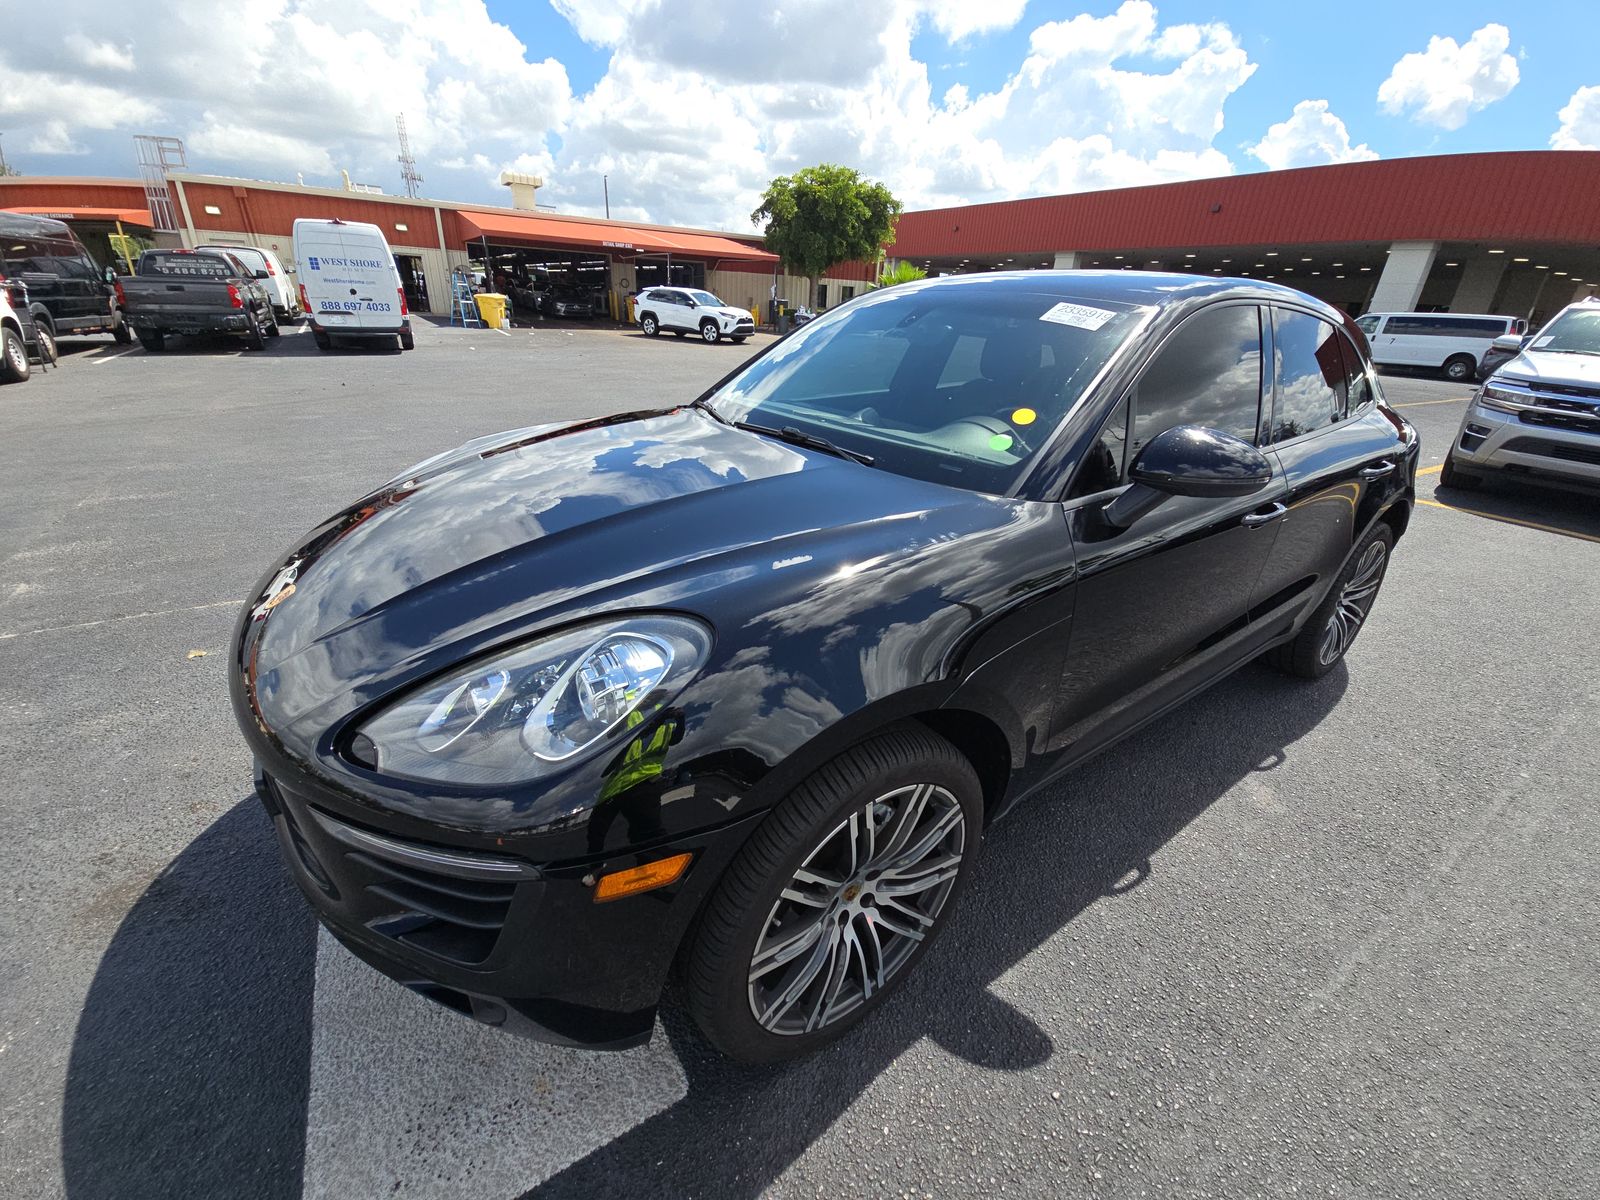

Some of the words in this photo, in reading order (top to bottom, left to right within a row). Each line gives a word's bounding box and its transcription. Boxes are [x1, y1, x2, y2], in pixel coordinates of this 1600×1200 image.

[320, 258, 348, 266] WEST
[350, 259, 382, 268] SHORE
[320, 301, 341, 310] 888
[343, 302, 362, 311] 697
[366, 302, 391, 312] 4033
[1057, 304, 1113, 321] 2335919
